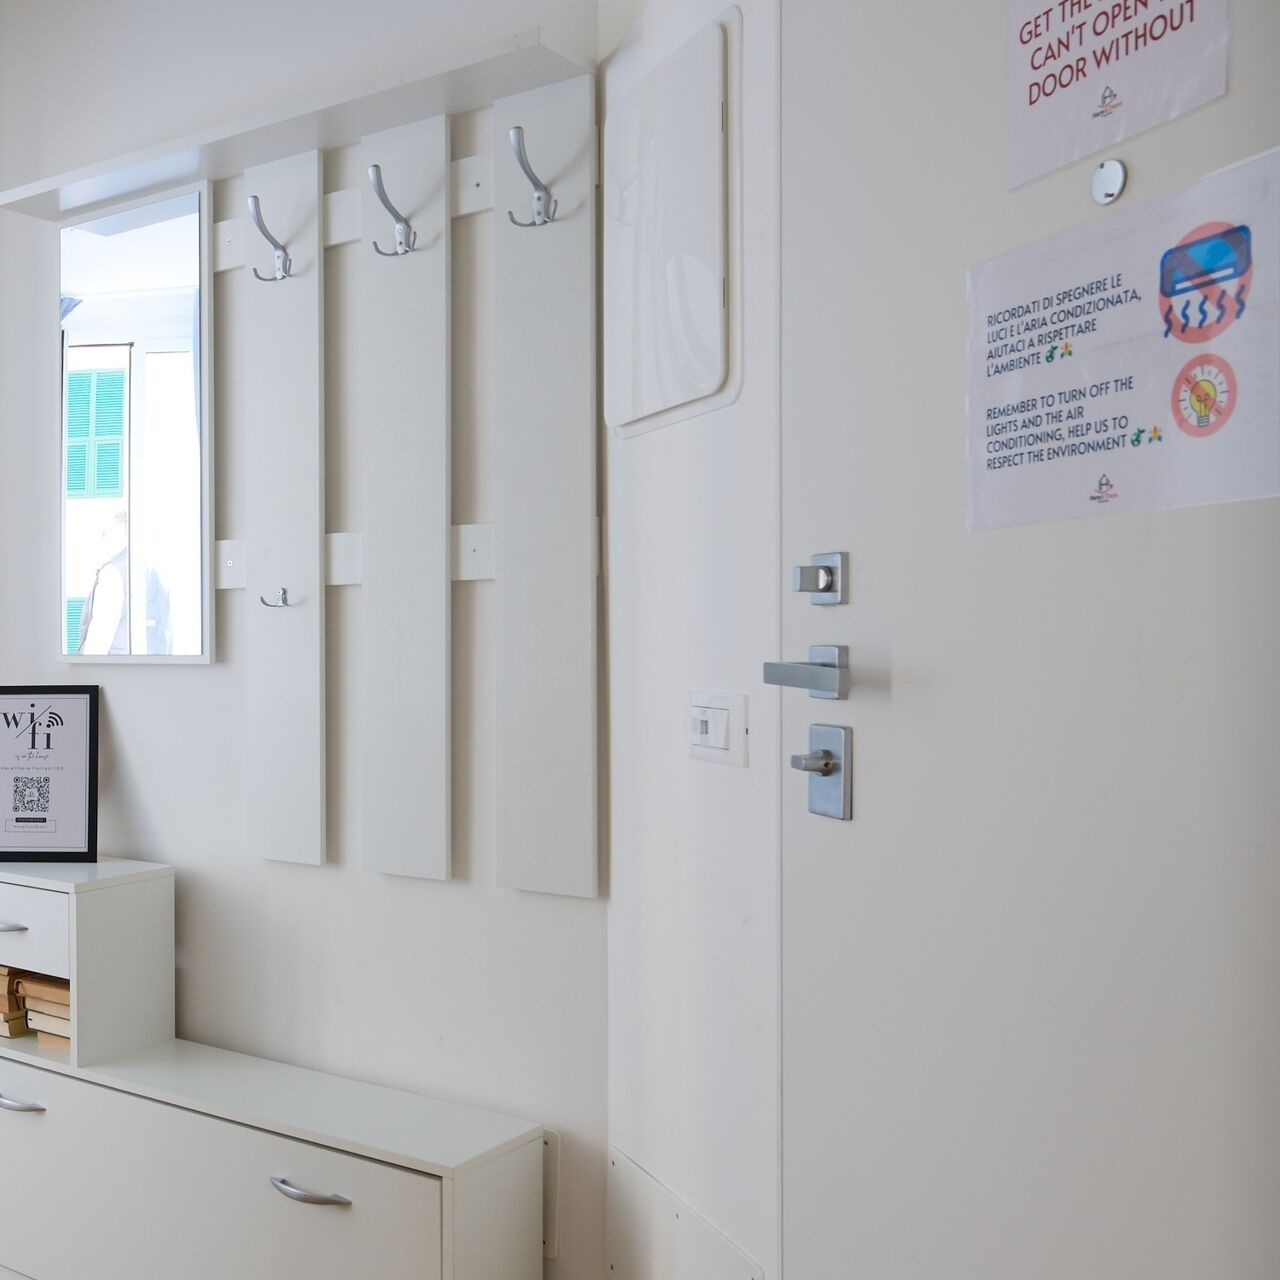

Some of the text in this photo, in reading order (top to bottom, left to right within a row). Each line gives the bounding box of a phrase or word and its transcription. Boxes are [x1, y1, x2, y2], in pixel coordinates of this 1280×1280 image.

[1020, 8, 1053, 44] GET
[1031, 22, 1087, 70] CAN'T
[1029, 57, 1087, 105] DOOR
[987, 274, 1122, 327] RICORDATI DI SPEGNERE LE
[987, 289, 1142, 343] LUCI E L'ARIA CONDIZIONATA,
[987, 319, 1097, 360] AIUTACI A RISPETTARE
[987, 352, 1041, 377] L'AMBIENTE
[987, 376, 1133, 420] REMEMBER TO TURN OFF THE
[987, 406, 1084, 437] LIGHTS AND THE AIR
[987, 416, 1128, 453] CONDITIONING, HELP US TO
[987, 434, 1127, 470] RESPECT THE ENVIRONMENT
[0, 703, 35, 728] wi
[28, 721, 53, 749] fi
